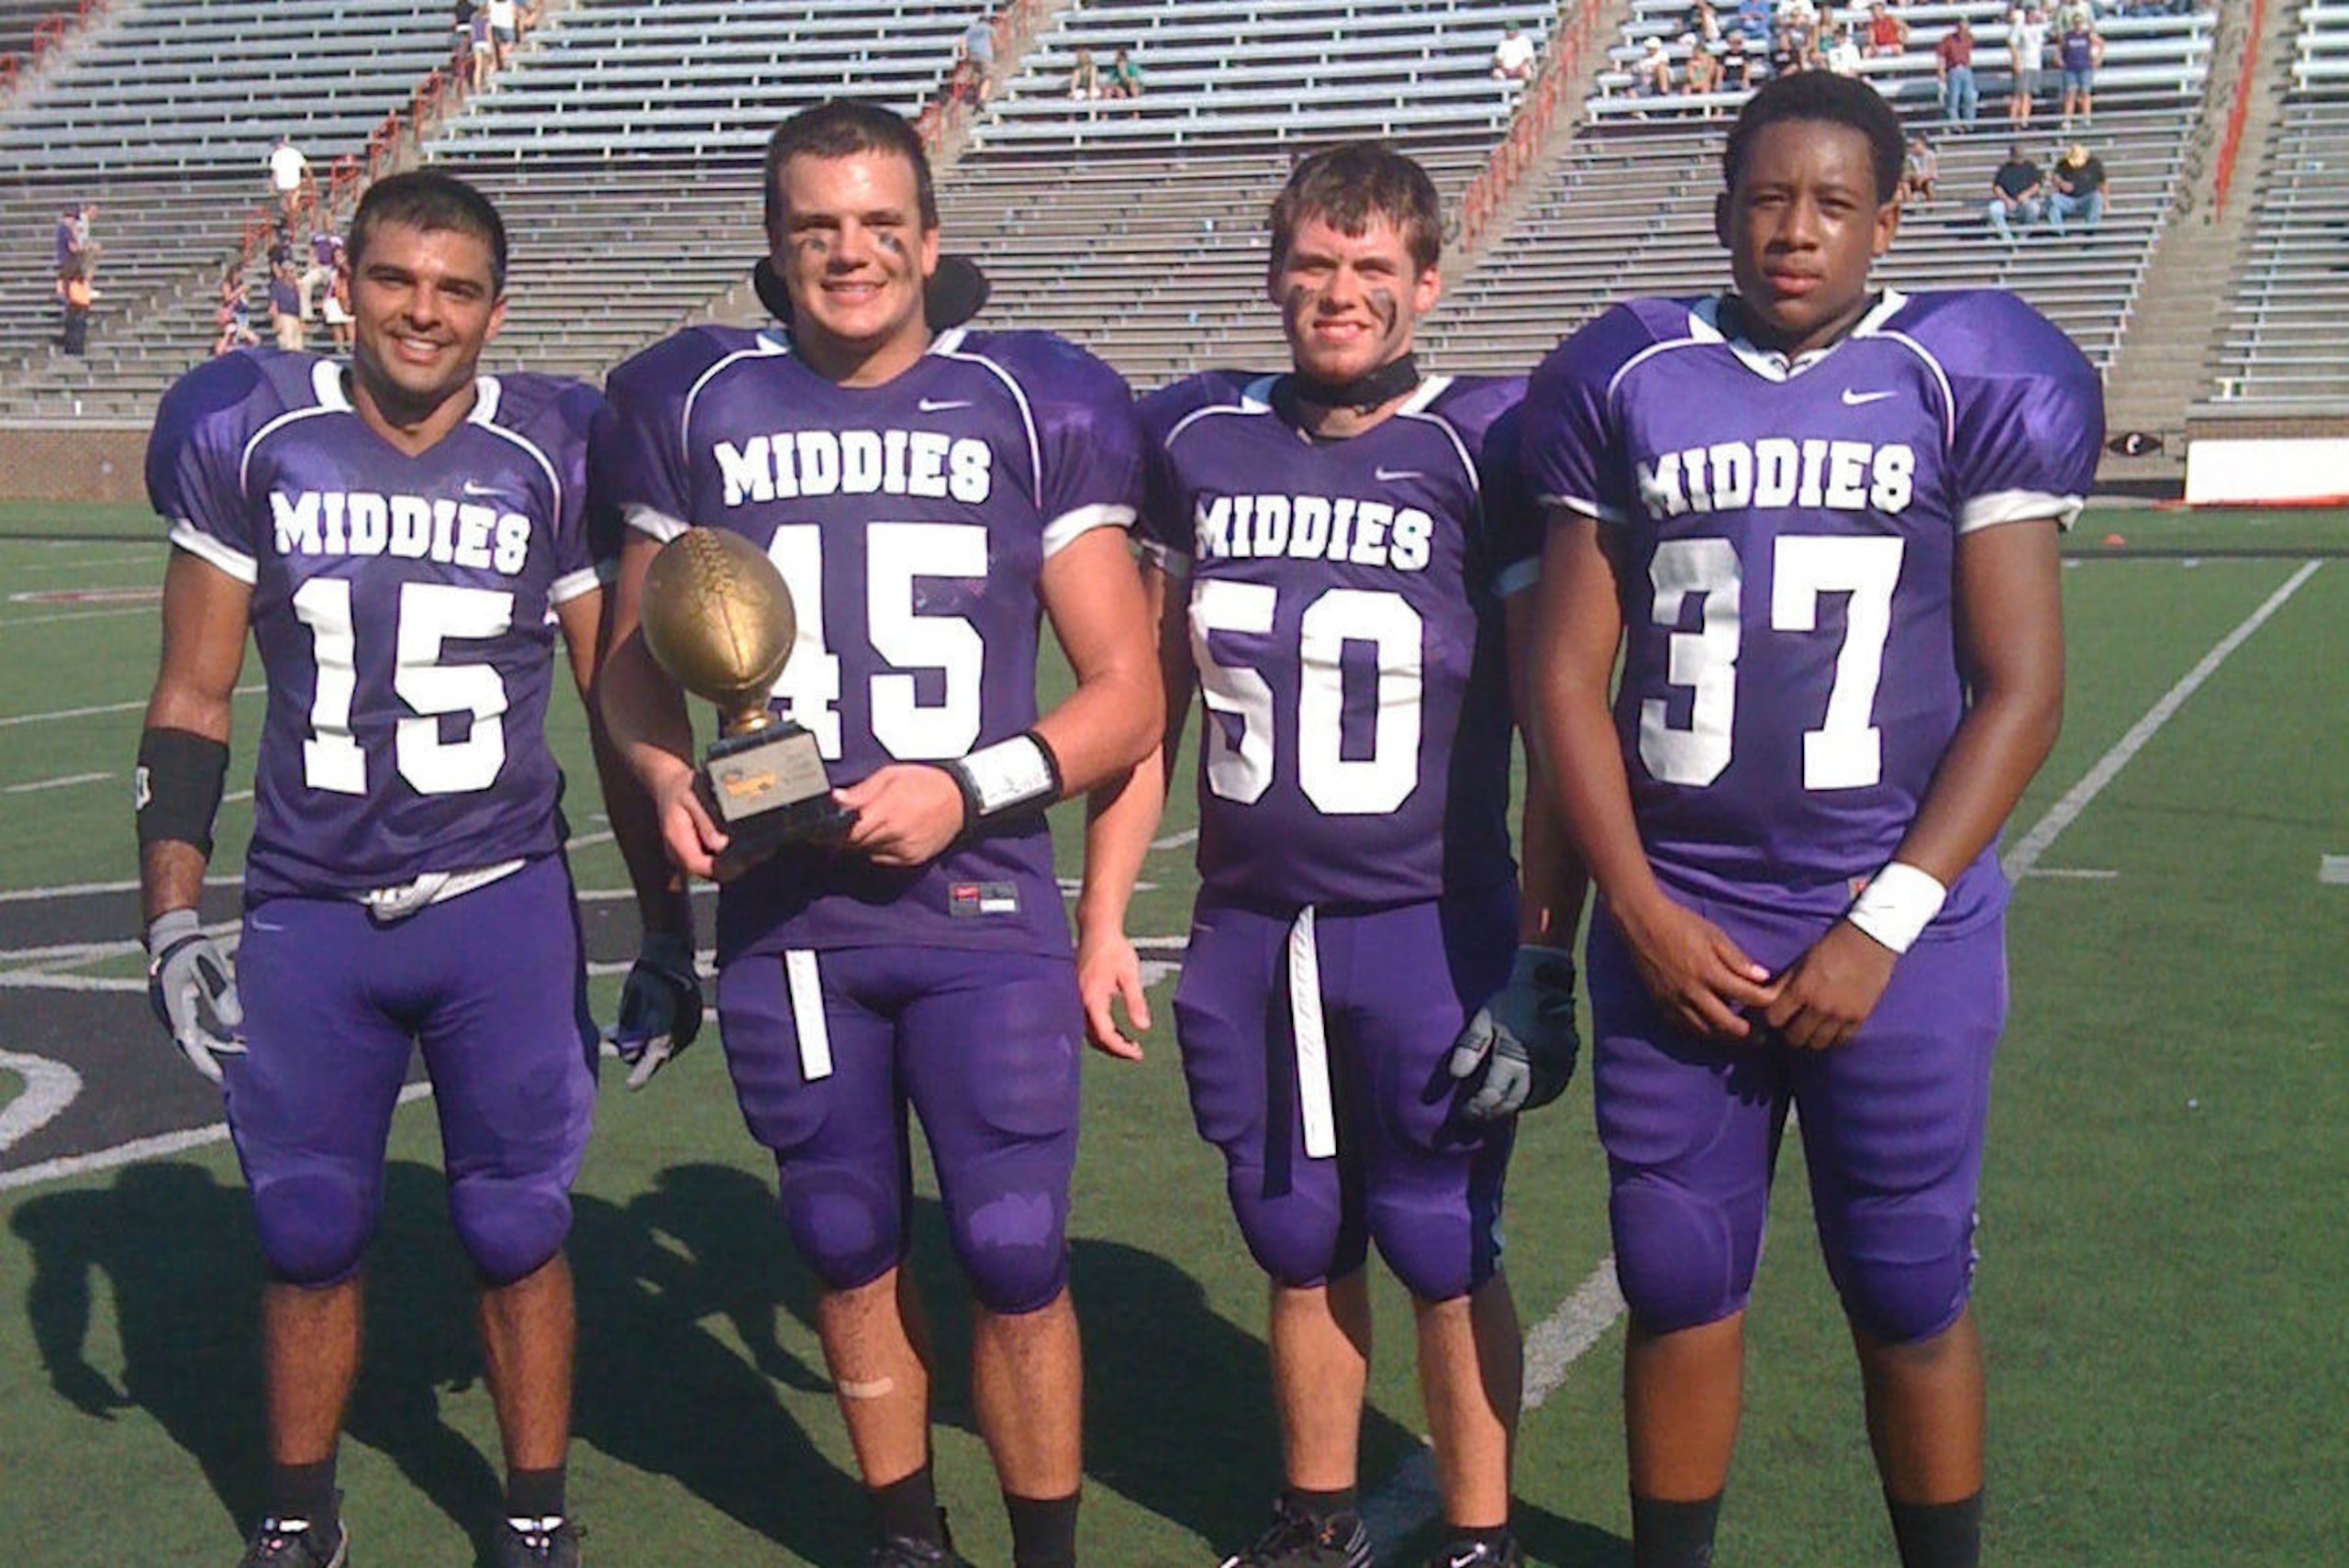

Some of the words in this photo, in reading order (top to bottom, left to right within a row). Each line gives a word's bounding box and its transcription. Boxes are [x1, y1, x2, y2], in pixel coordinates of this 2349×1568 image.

[270, 491, 531, 574] MIDDIES
[713, 429, 992, 507] MIDDIES
[1196, 495, 1434, 572] MIDDIES
[1638, 437, 1916, 520] MIDDIES
[292, 576, 515, 795] 15
[767, 521, 990, 762] 45
[1187, 579, 1424, 815] 50
[1639, 534, 1905, 791] 37
